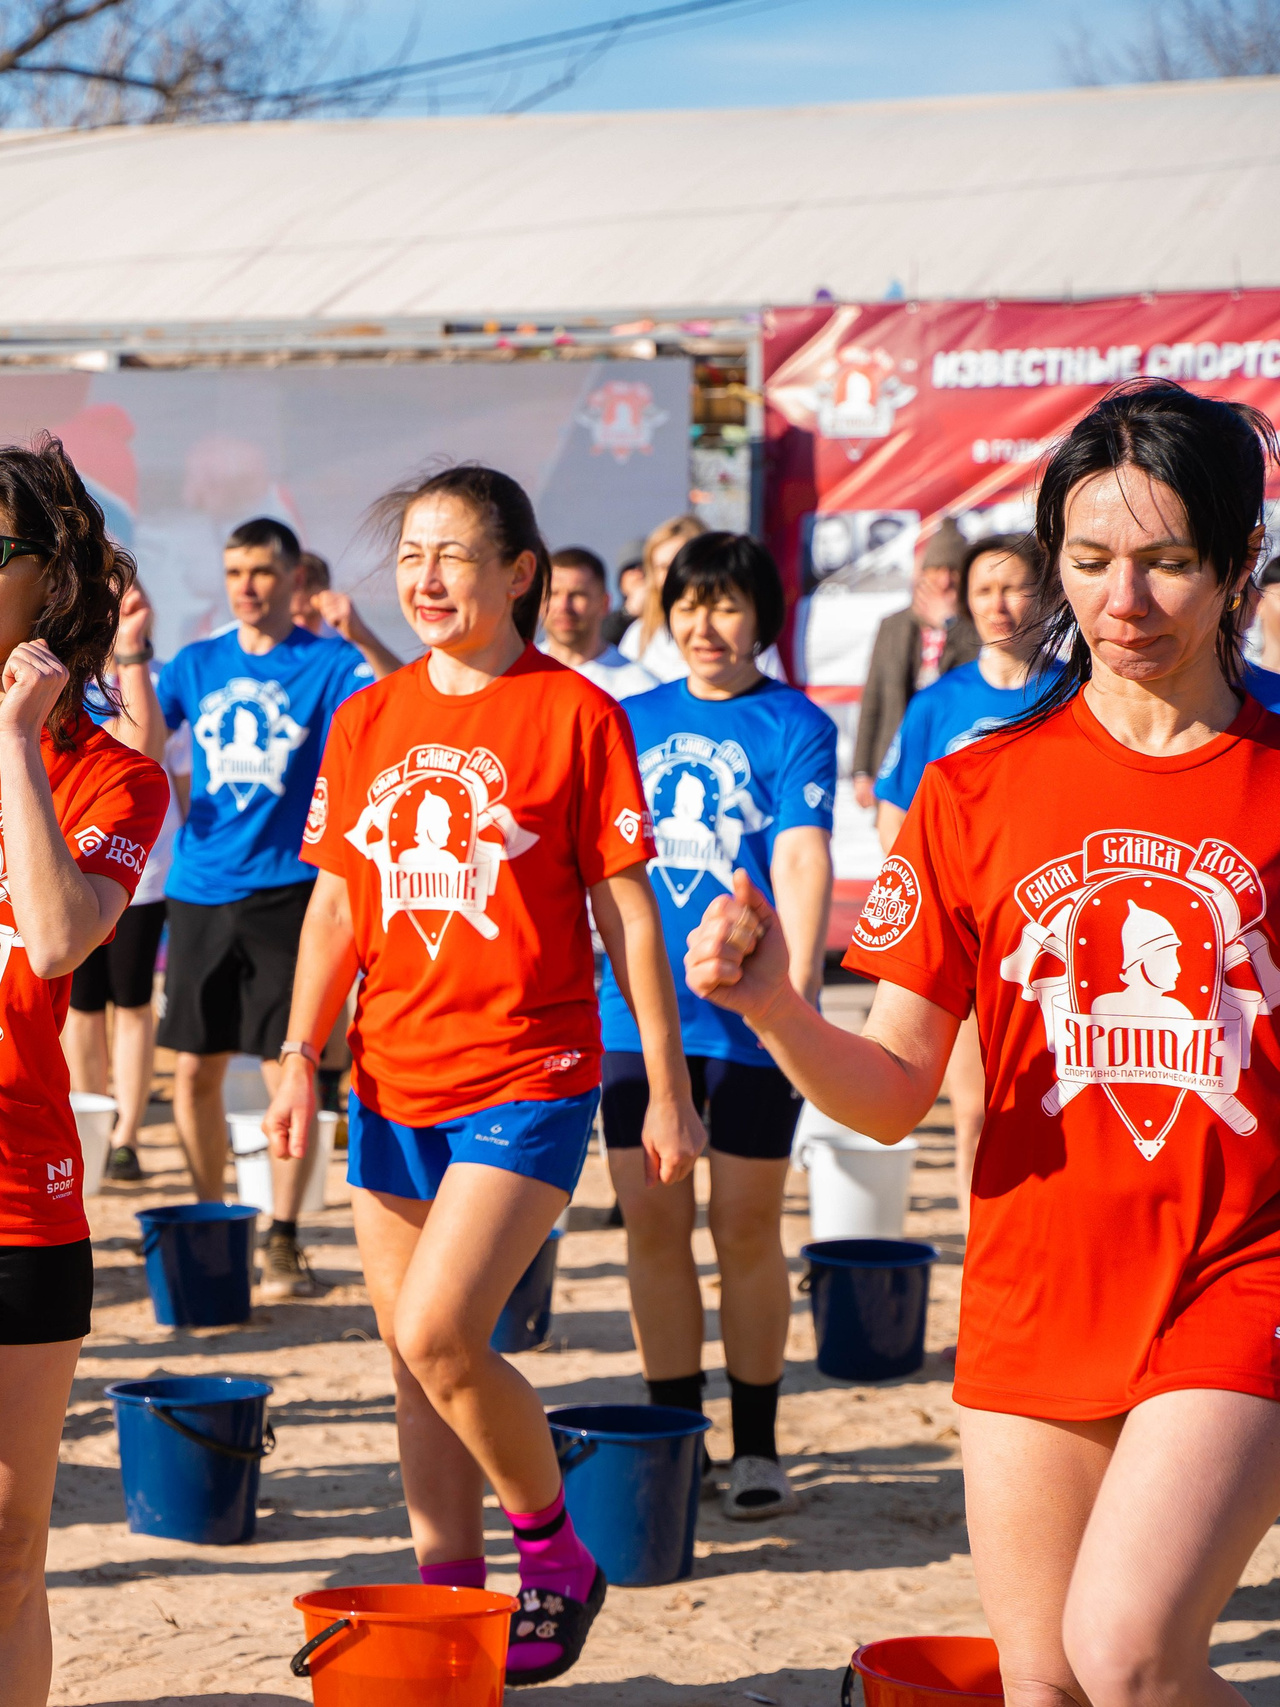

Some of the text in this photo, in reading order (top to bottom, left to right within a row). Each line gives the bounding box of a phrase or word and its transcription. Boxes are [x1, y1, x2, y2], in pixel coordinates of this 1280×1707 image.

[931, 344, 1141, 389] ИЗВЕСТНЫЕ
[1103, 836, 1182, 873] СЛАВА
[1200, 842, 1258, 897] ДОЛГ
[1025, 863, 1078, 909] СИЛА
[1064, 1018, 1226, 1078] ЯРОПОЛК
[1064, 1067, 1226, 1089] СПОРТИВНО-ПАТРИОТИЧЕСКИЙ КЛУБ
[47, 1178, 74, 1194] SPORT
